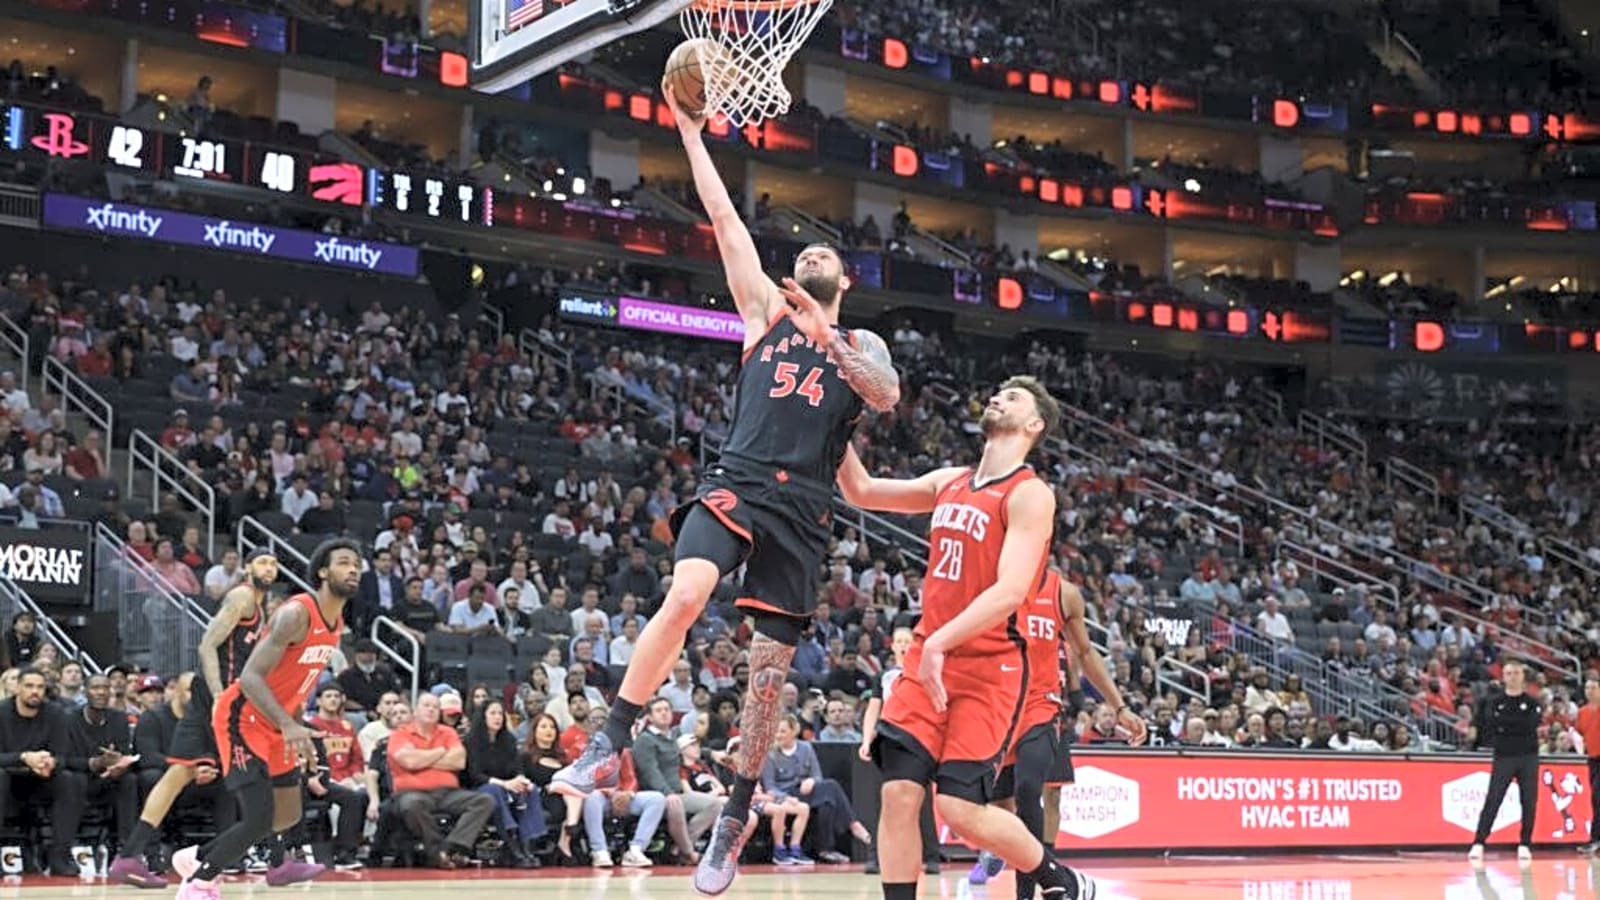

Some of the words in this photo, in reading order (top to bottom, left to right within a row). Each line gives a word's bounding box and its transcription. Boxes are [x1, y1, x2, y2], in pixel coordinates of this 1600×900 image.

[108, 126, 144, 168] 42
[181, 138, 226, 174] 7:01
[261, 152, 295, 192] 40
[86, 203, 163, 237] xfinity
[203, 220, 276, 252] xfinity
[314, 237, 383, 268] xfinity
[559, 297, 604, 316] reliant
[624, 306, 680, 327] OFFICIAL
[681, 315, 727, 332] ENERGY
[769, 361, 824, 407] 54
[932, 537, 963, 581] 28
[1060, 785, 1129, 802] HAMPION
[1177, 776, 1294, 800] HOUSTON'S
[1298, 777, 1319, 800] #1
[1324, 778, 1402, 800] TRUSTED
[1076, 805, 1117, 822] NASH
[1241, 805, 1295, 828] HVAC
[1298, 805, 1350, 828] TEAM
